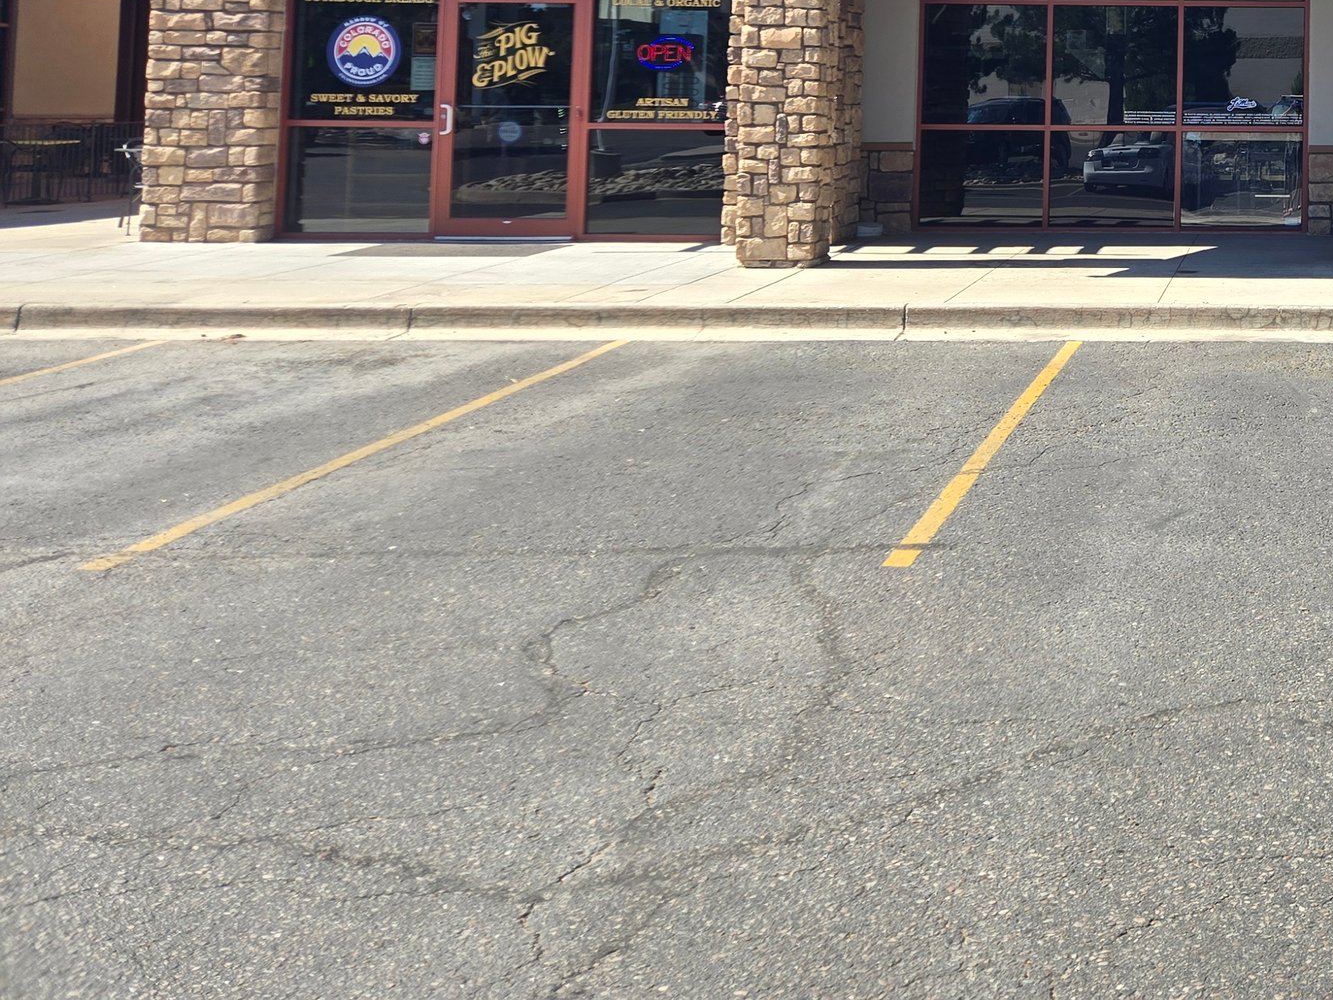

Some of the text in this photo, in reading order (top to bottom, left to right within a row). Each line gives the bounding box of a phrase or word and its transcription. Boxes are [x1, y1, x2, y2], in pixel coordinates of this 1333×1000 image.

[339, 26, 391, 49] COLORADO
[495, 23, 541, 56] PIG
[637, 44, 691, 62] OPEN
[343, 62, 384, 77] PROUD
[489, 46, 556, 82] PLOW
[310, 94, 419, 103] SWEET & SAVORY
[636, 98, 689, 107] ARTISAN
[334, 106, 395, 116] PASTRIES
[607, 110, 718, 120] GLUTEN FRIENDLY
